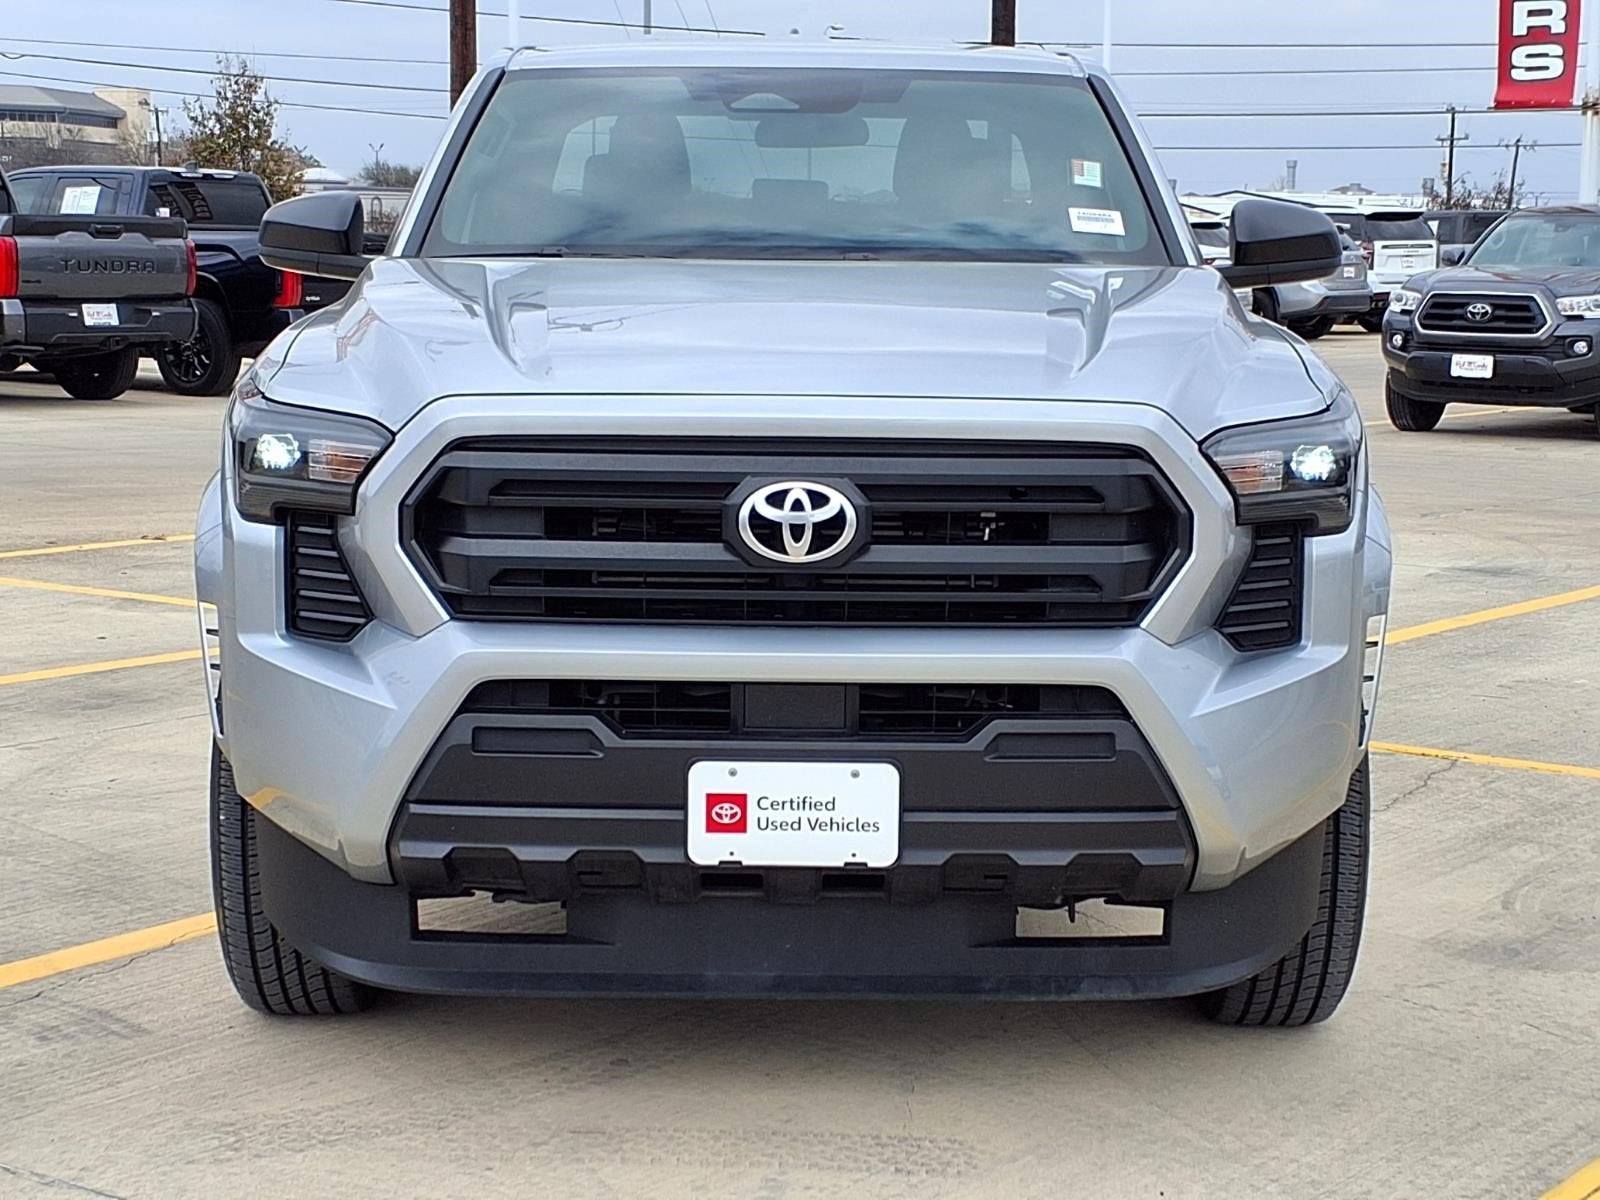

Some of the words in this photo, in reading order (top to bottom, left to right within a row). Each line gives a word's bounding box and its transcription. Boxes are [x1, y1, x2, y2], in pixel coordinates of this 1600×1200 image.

[60, 259, 157, 274] TUNDRA
[757, 796, 836, 812] Certified
[757, 816, 802, 832] Used
[807, 817, 880, 833] Vehicles
